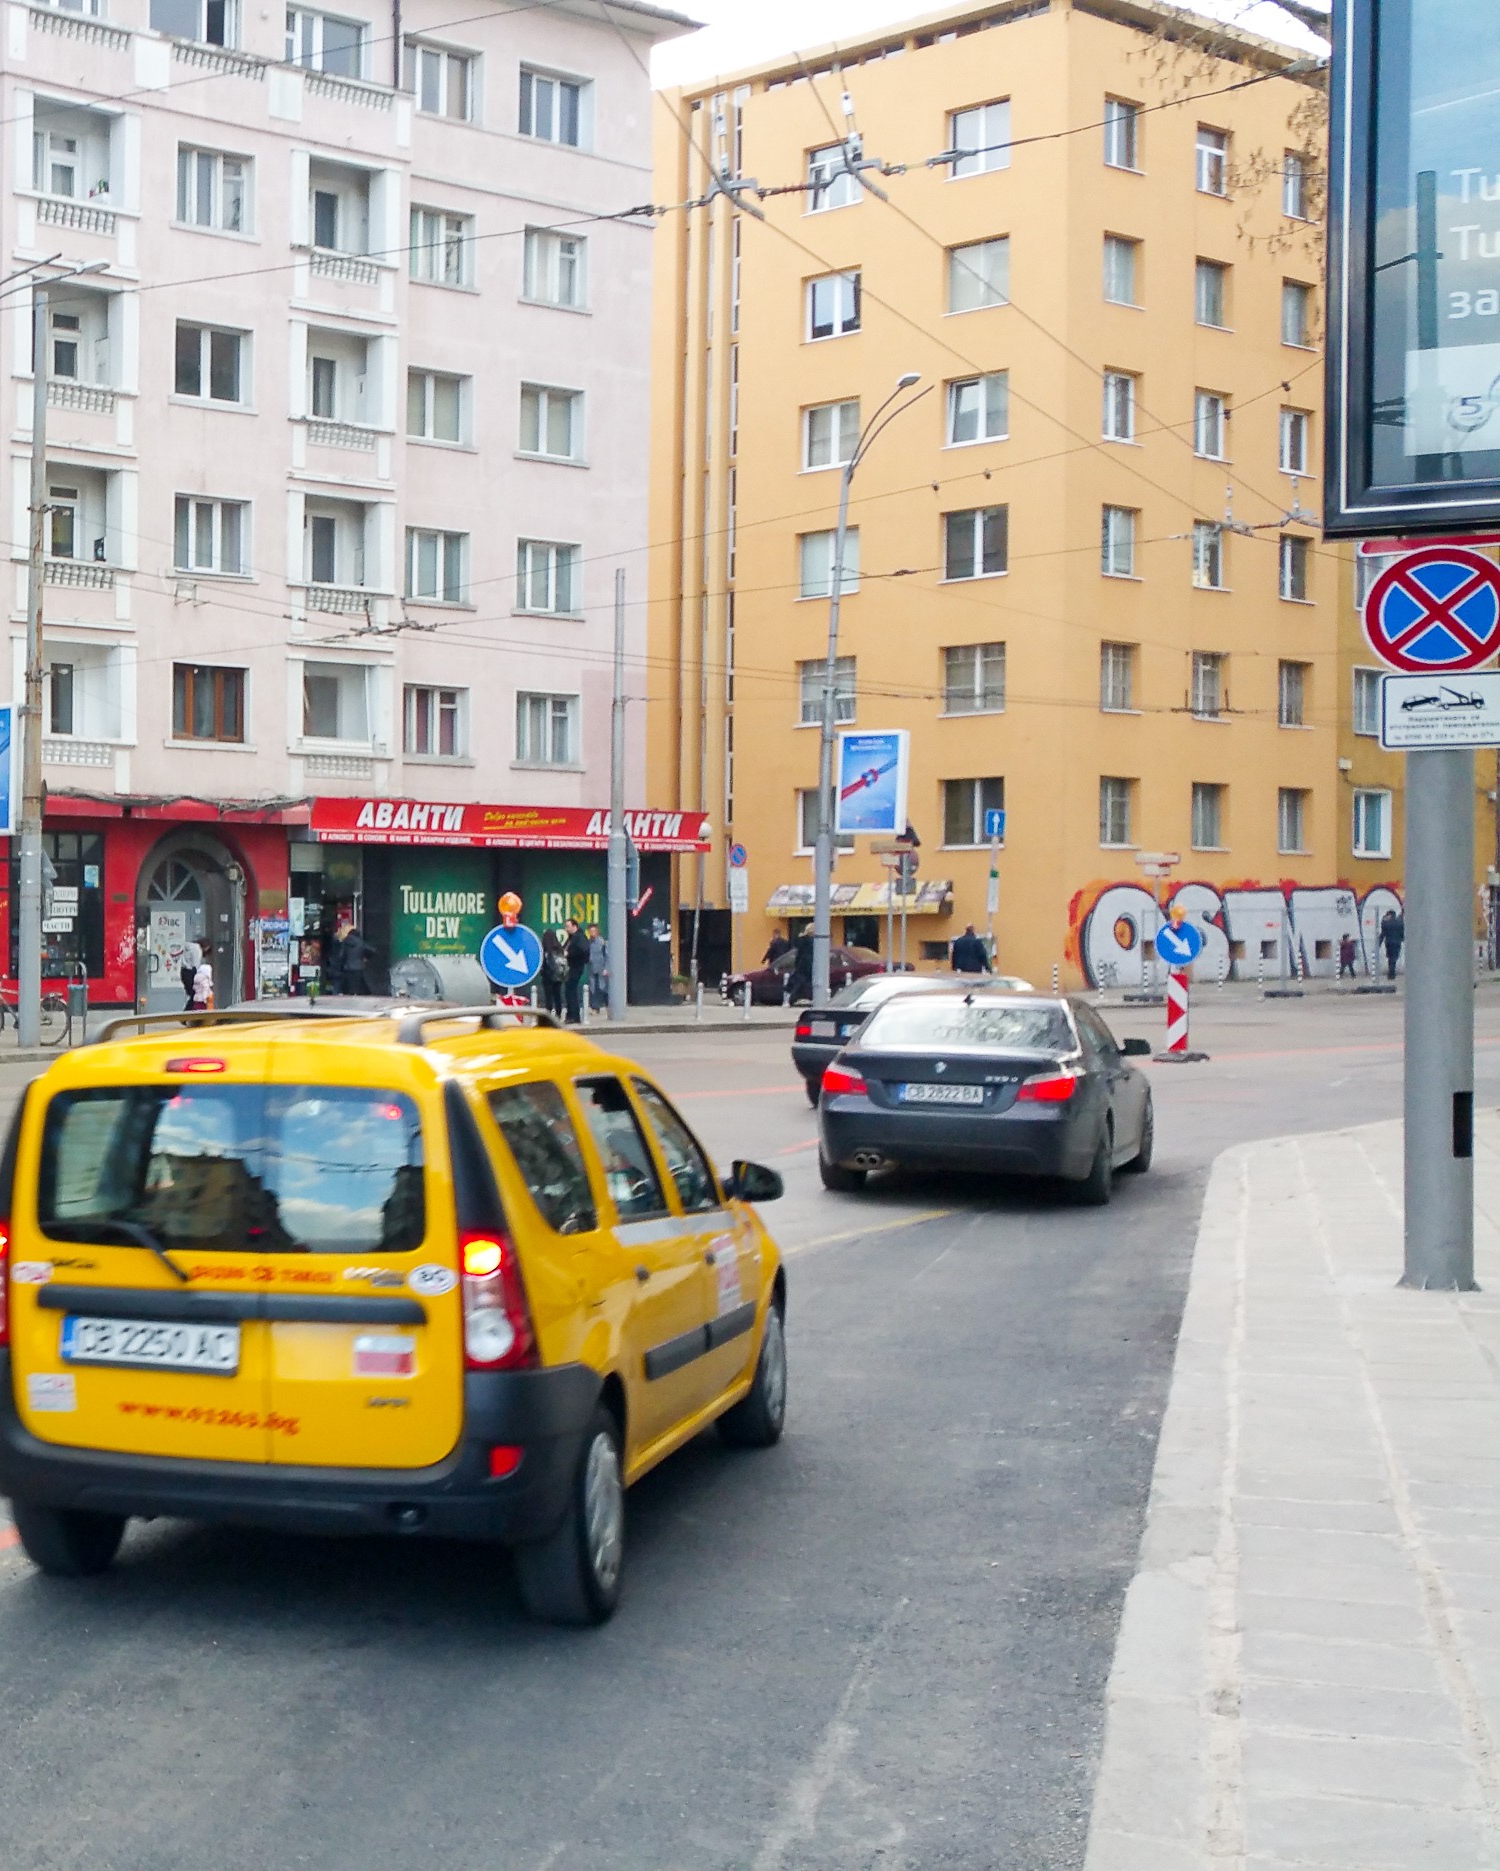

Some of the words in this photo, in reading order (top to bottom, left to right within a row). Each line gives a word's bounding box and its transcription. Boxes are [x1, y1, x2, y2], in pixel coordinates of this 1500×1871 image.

[356, 801, 465, 832] АВАНТИ
[400, 885, 486, 915] TULLAMORE
[541, 892, 600, 924] IRISH
[426, 917, 460, 939] DEW
